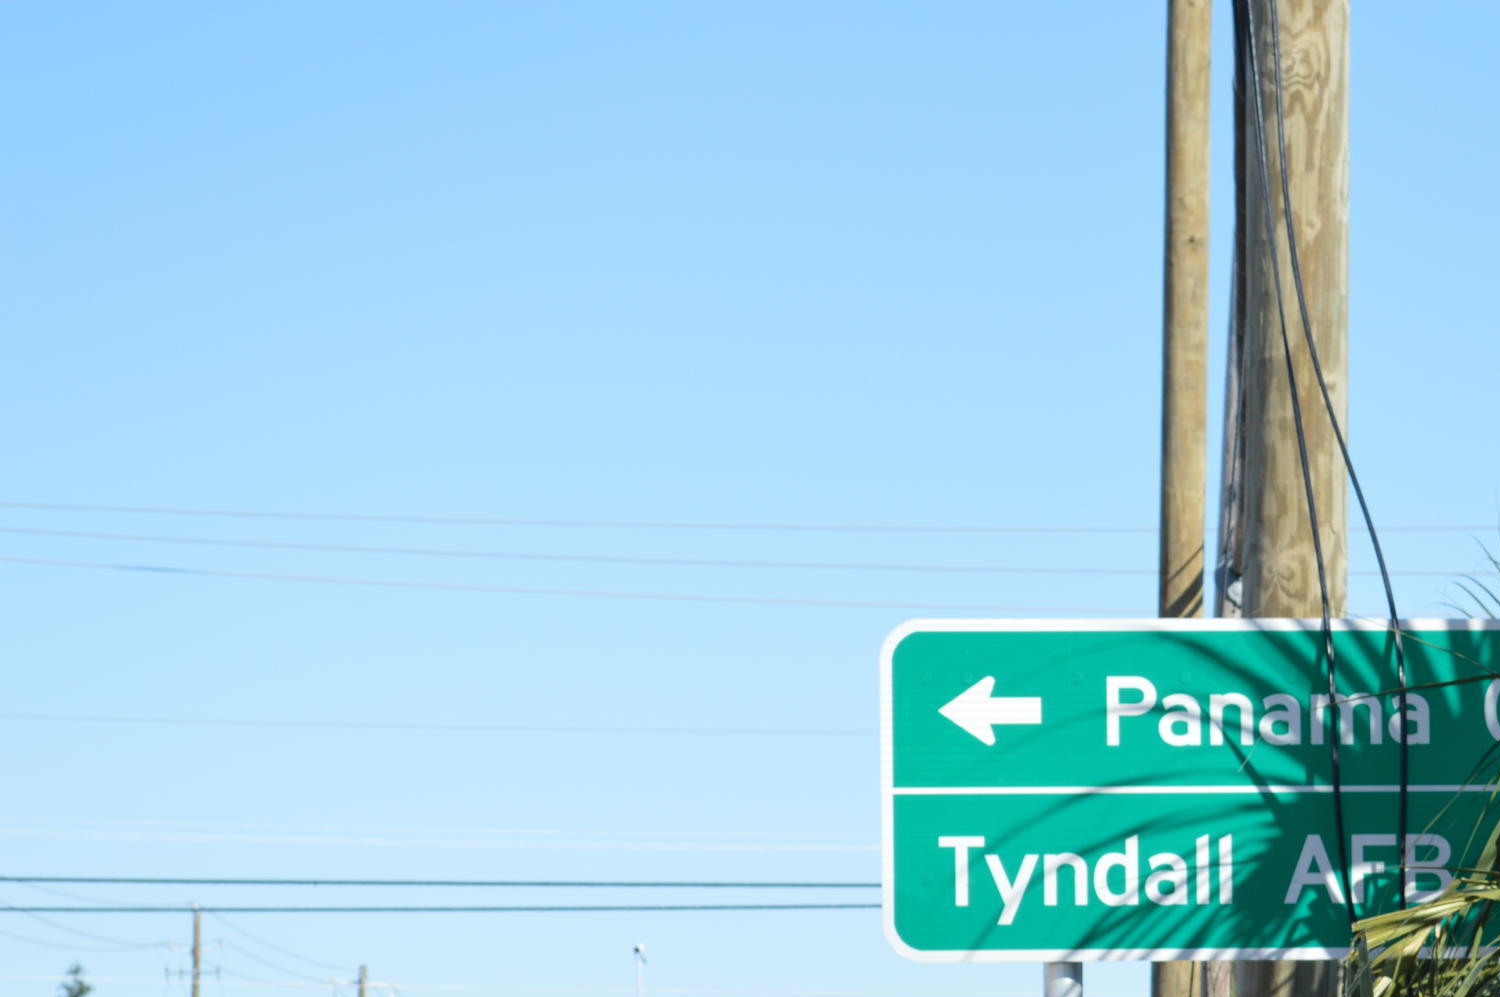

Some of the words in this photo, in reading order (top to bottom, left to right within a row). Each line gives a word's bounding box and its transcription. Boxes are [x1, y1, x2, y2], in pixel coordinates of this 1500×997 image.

[1104, 675, 1431, 748] Panama
[938, 834, 1233, 926] Tyndall
[1284, 832, 1452, 905] AFB
